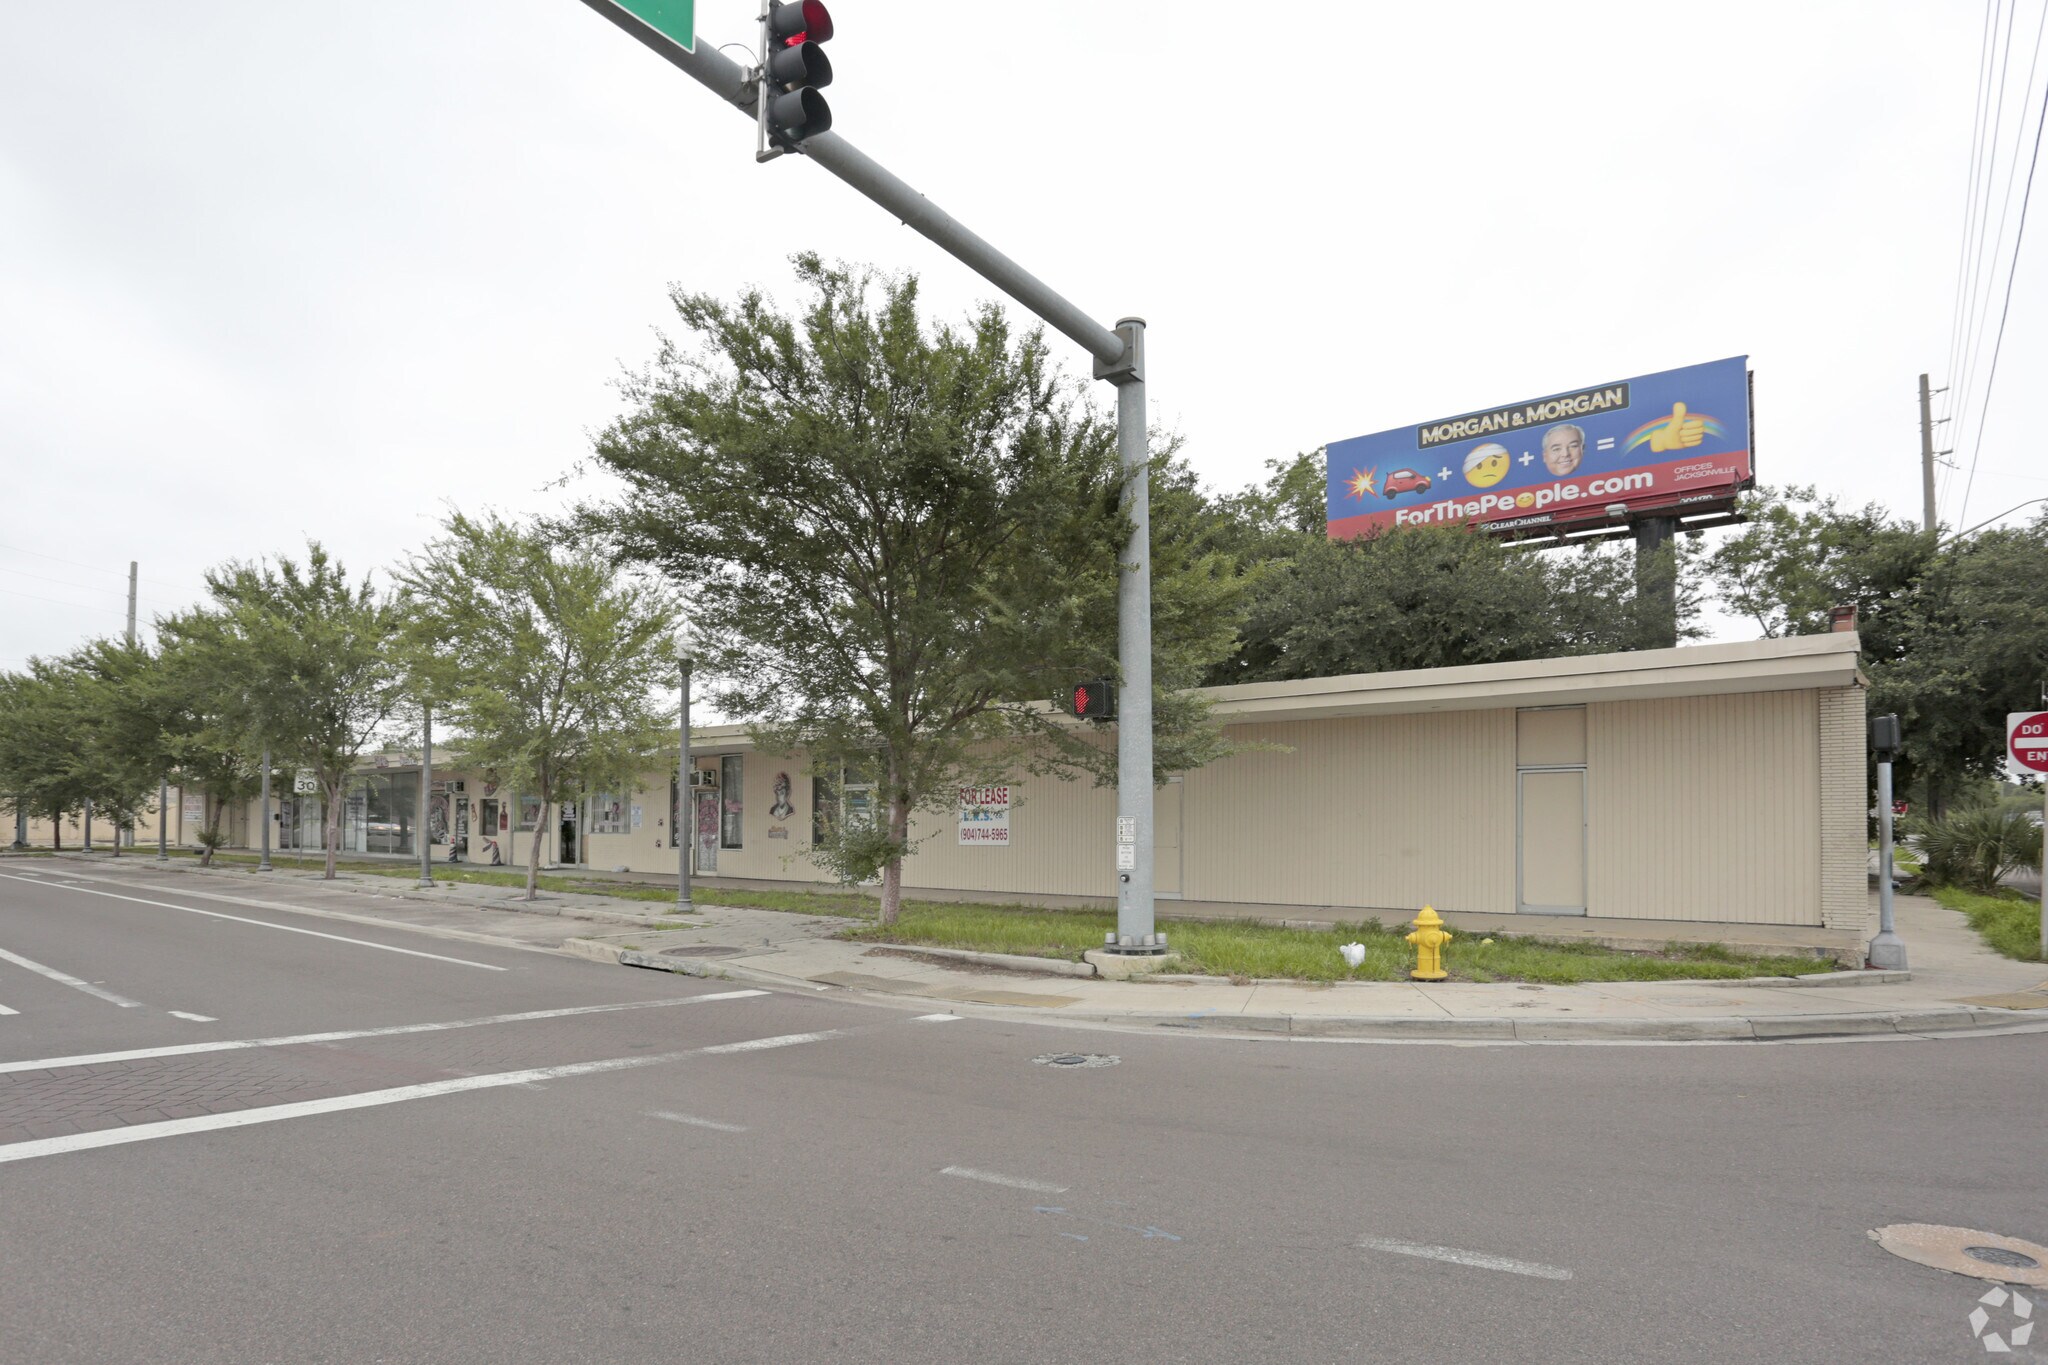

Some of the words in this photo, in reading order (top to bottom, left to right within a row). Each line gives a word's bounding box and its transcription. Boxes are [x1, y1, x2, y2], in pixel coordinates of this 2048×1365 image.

[1421, 411, 1509, 445] MORGAN
[1511, 412, 1526, 427] &
[1526, 387, 1623, 424] MORGAN
[1674, 462, 1713, 474] OFFICES
[1674, 466, 1737, 482] JACKSONVILLE
[2021, 724, 2043, 735] DO
[297, 780, 315, 791] 30
[960, 787, 978, 805] FOR
[979, 787, 1008, 805] LEASE
[961, 828, 1008, 841] (904)744-5965
